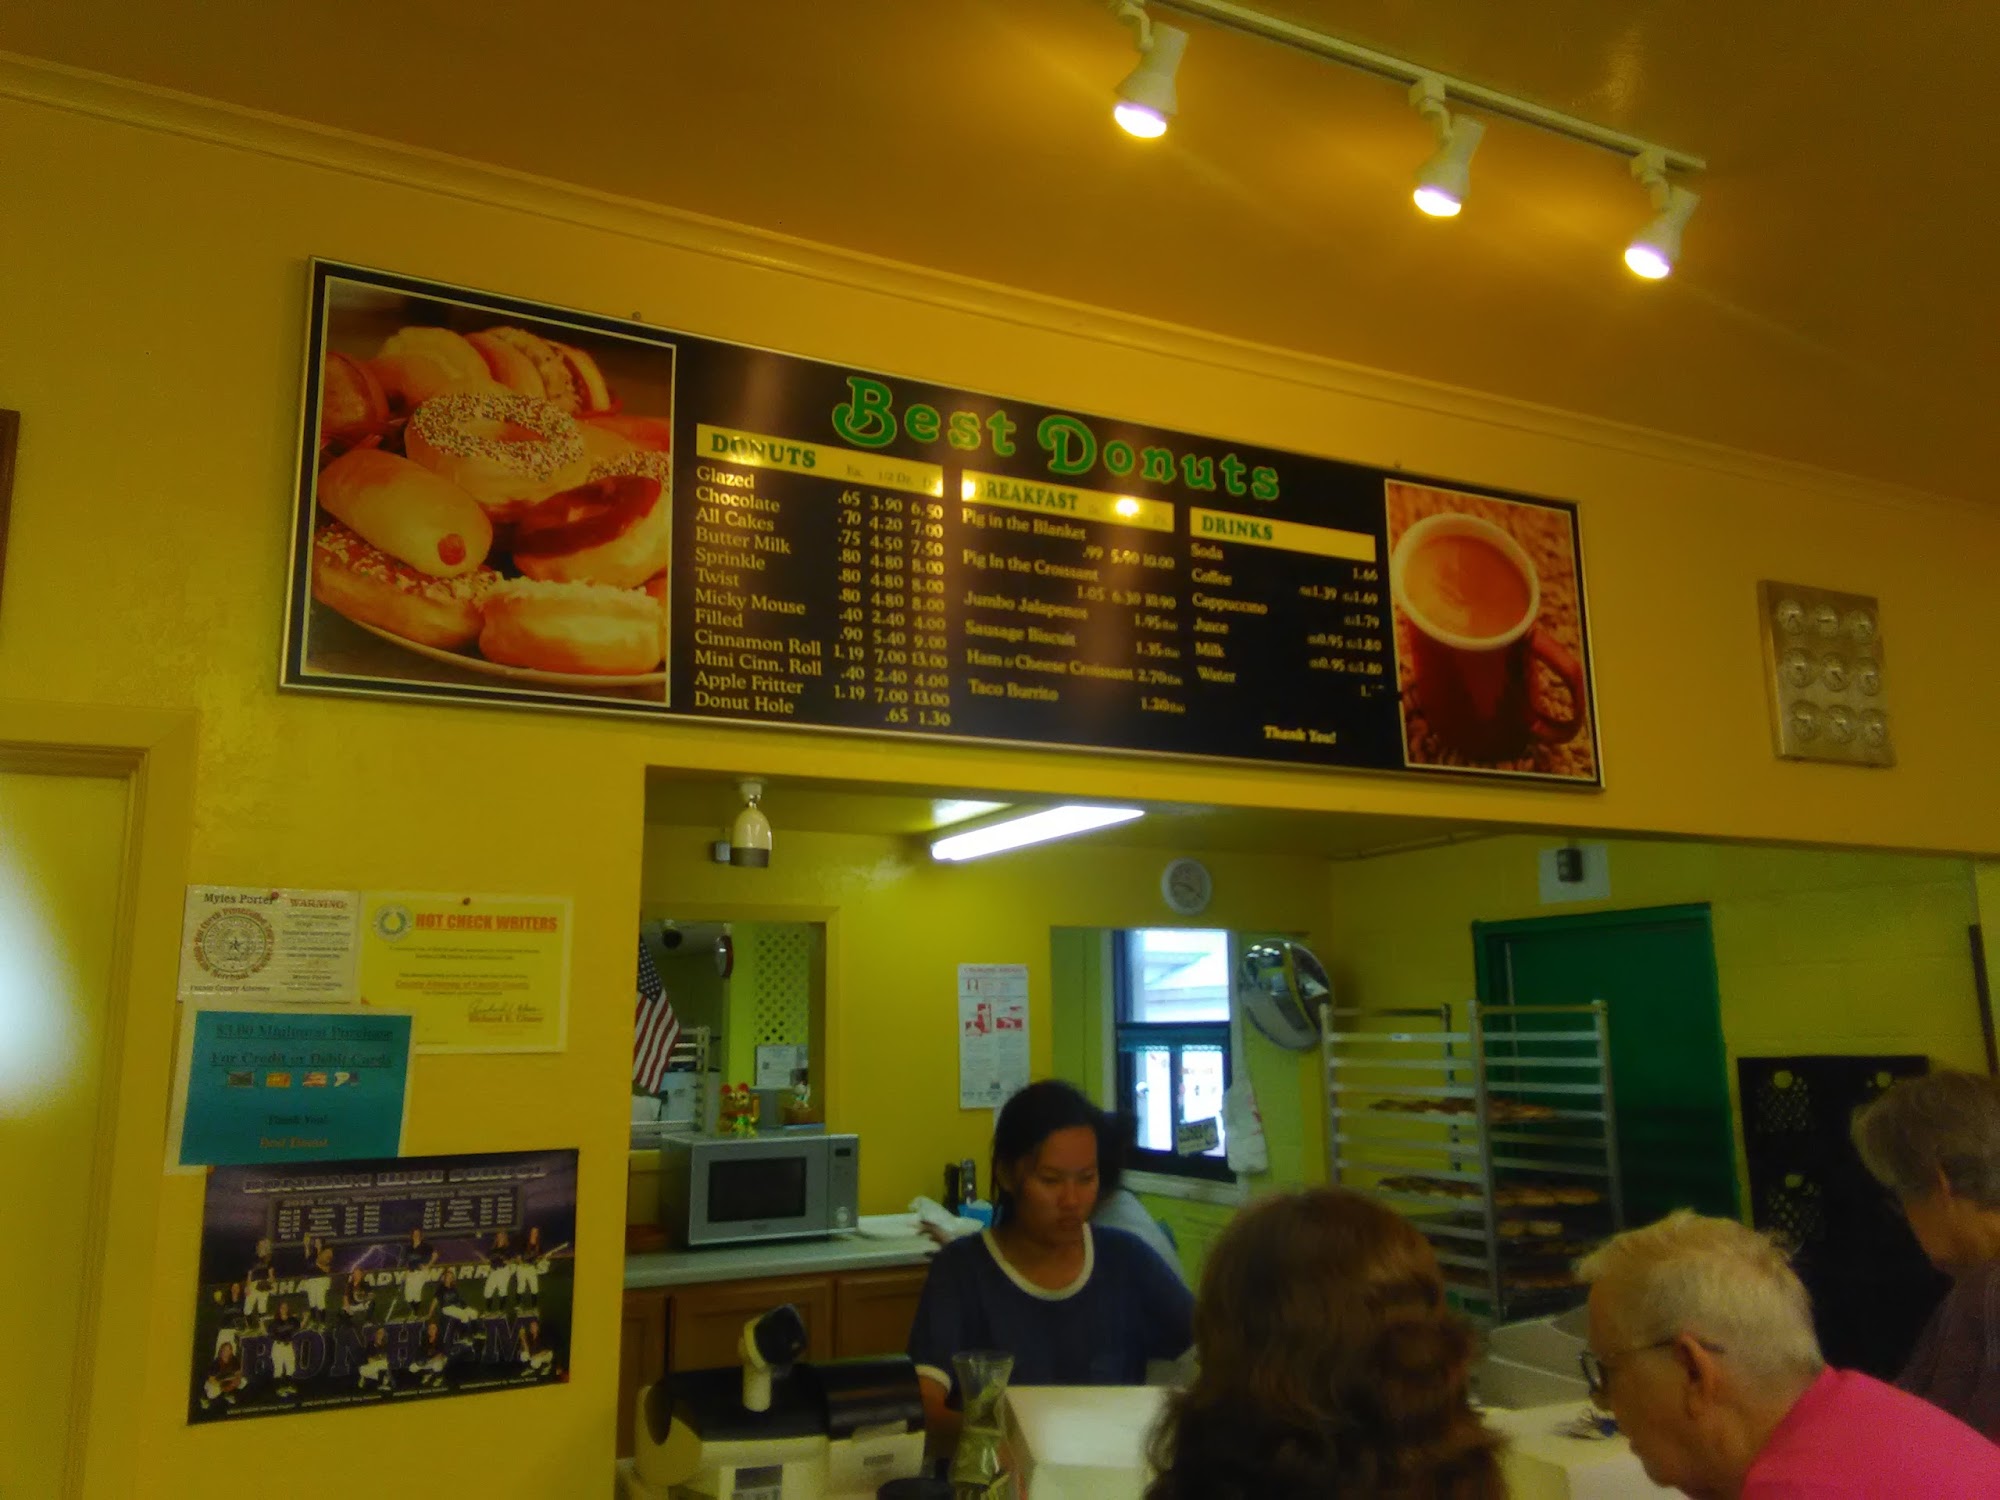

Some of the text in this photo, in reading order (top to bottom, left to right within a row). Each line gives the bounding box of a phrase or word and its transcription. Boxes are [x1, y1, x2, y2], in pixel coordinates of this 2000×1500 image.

[831, 375, 1280, 501] Best Donuts
[711, 434, 817, 468] DONUTS
[696, 465, 756, 489] Glazed
[696, 486, 781, 513] Chocolate
[837, 490, 861, 507] .65
[976, 478, 1079, 511] REAKFAST
[696, 507, 775, 532] All Cakes
[838, 509, 861, 526] .70
[962, 507, 986, 529] Pig
[1006, 515, 1030, 532] the
[1033, 518, 1087, 541] Blanket
[1202, 515, 1273, 540] DRINKS
[696, 526, 792, 555] Butter Milk
[838, 530, 861, 546] .75
[695, 546, 766, 571] Sprinkle
[838, 549, 861, 565] .80
[963, 549, 987, 571] Pig
[1008, 555, 1031, 573] the
[1190, 542, 1224, 561] Soda
[695, 567, 740, 588] Twist
[838, 568, 861, 584] .80
[1191, 567, 1233, 586] Coffee
[695, 588, 806, 616] Micky Mouse
[838, 588, 861, 603] .80
[964, 590, 1016, 611] Jumbo
[1192, 592, 1268, 615] Cappuccino
[695, 608, 744, 629] Filled
[838, 607, 863, 622] .40
[840, 627, 864, 642] .90
[964, 619, 1076, 648] Sausage Biscuit
[1193, 618, 1229, 634] Juice
[695, 629, 822, 656] Cinnamon Roll
[1195, 642, 1225, 658] Milk
[695, 650, 823, 677] Mini Cinn. Roll
[840, 666, 865, 682] .40
[966, 648, 1003, 668] Ham
[1015, 654, 1067, 674] Cheese
[1069, 659, 1134, 681] Croissant
[1196, 665, 1237, 683] Water
[694, 671, 804, 695] Apple Fritter
[968, 678, 1059, 702] Taco Burrito
[694, 691, 794, 714] Donut Hole
[885, 709, 909, 724] .65
[1263, 724, 1337, 745] Thank You!
[204, 893, 274, 906] Myles Porter
[416, 914, 558, 931] HOT CHECK WRITERS
